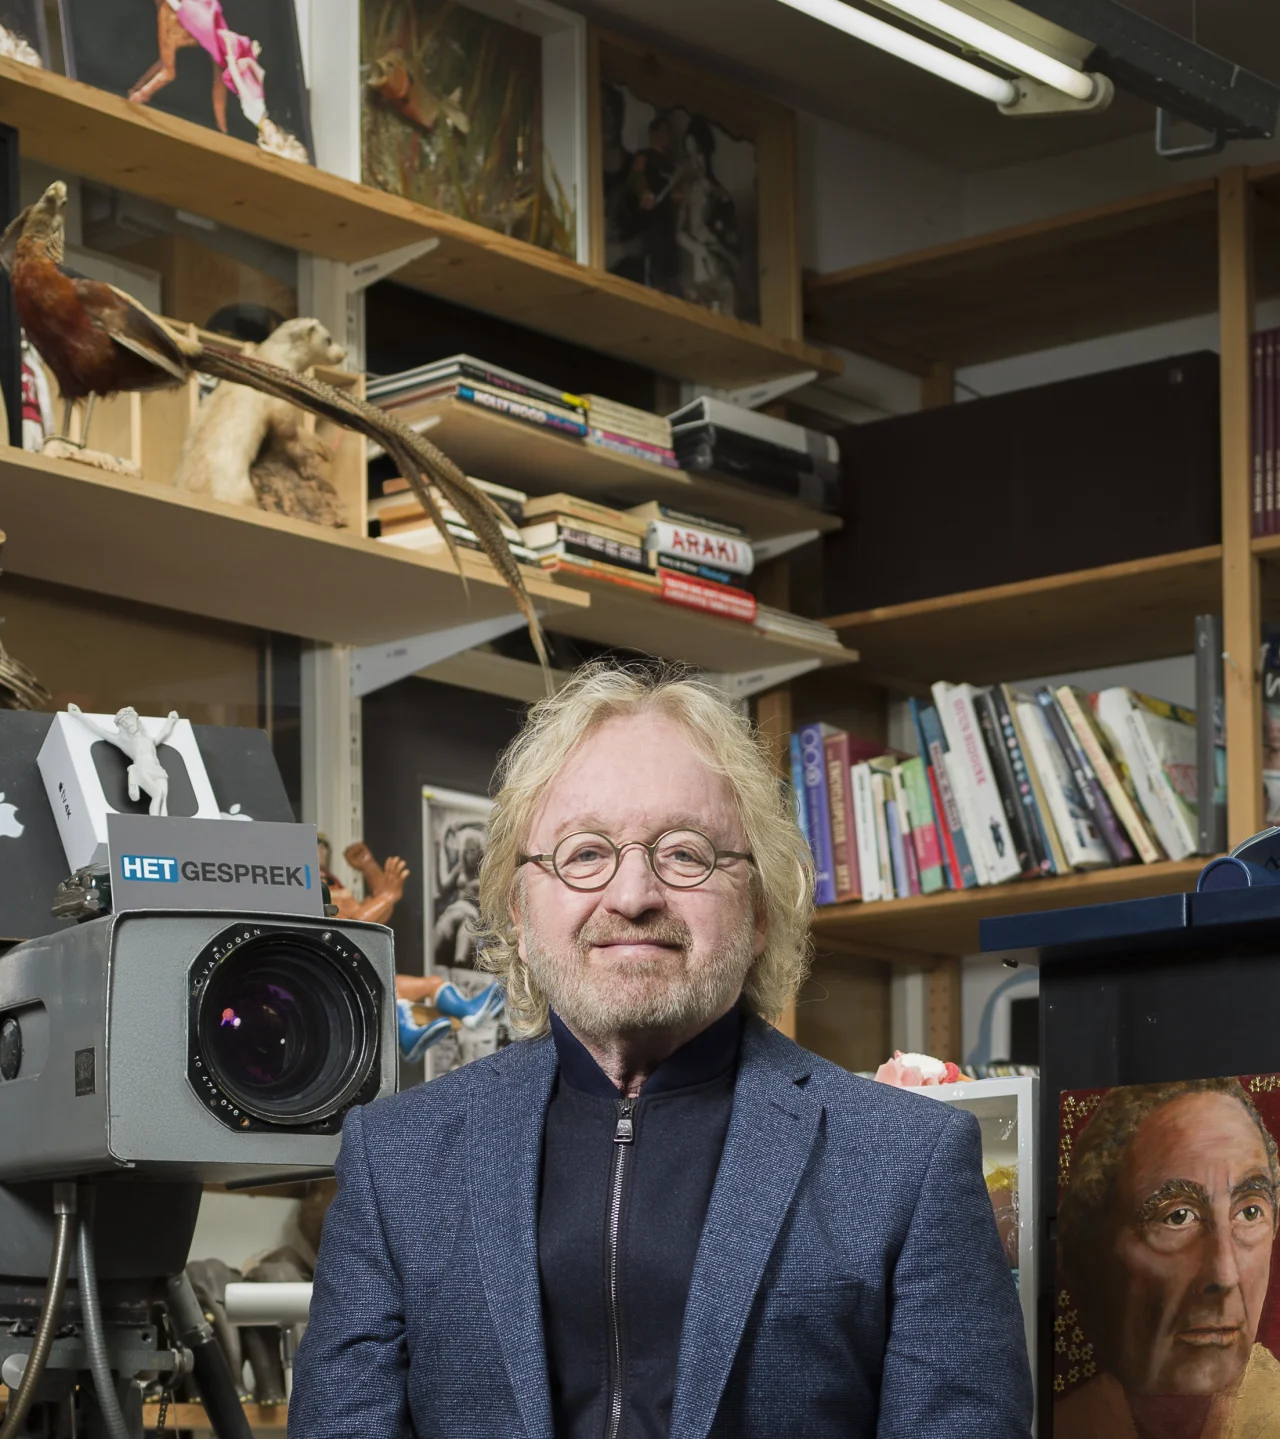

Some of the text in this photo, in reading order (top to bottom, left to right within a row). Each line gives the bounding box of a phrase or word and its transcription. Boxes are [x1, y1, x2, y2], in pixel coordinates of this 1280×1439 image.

[672, 529, 737, 564] ARAKI
[123, 857, 304, 887] HET GESPREK
